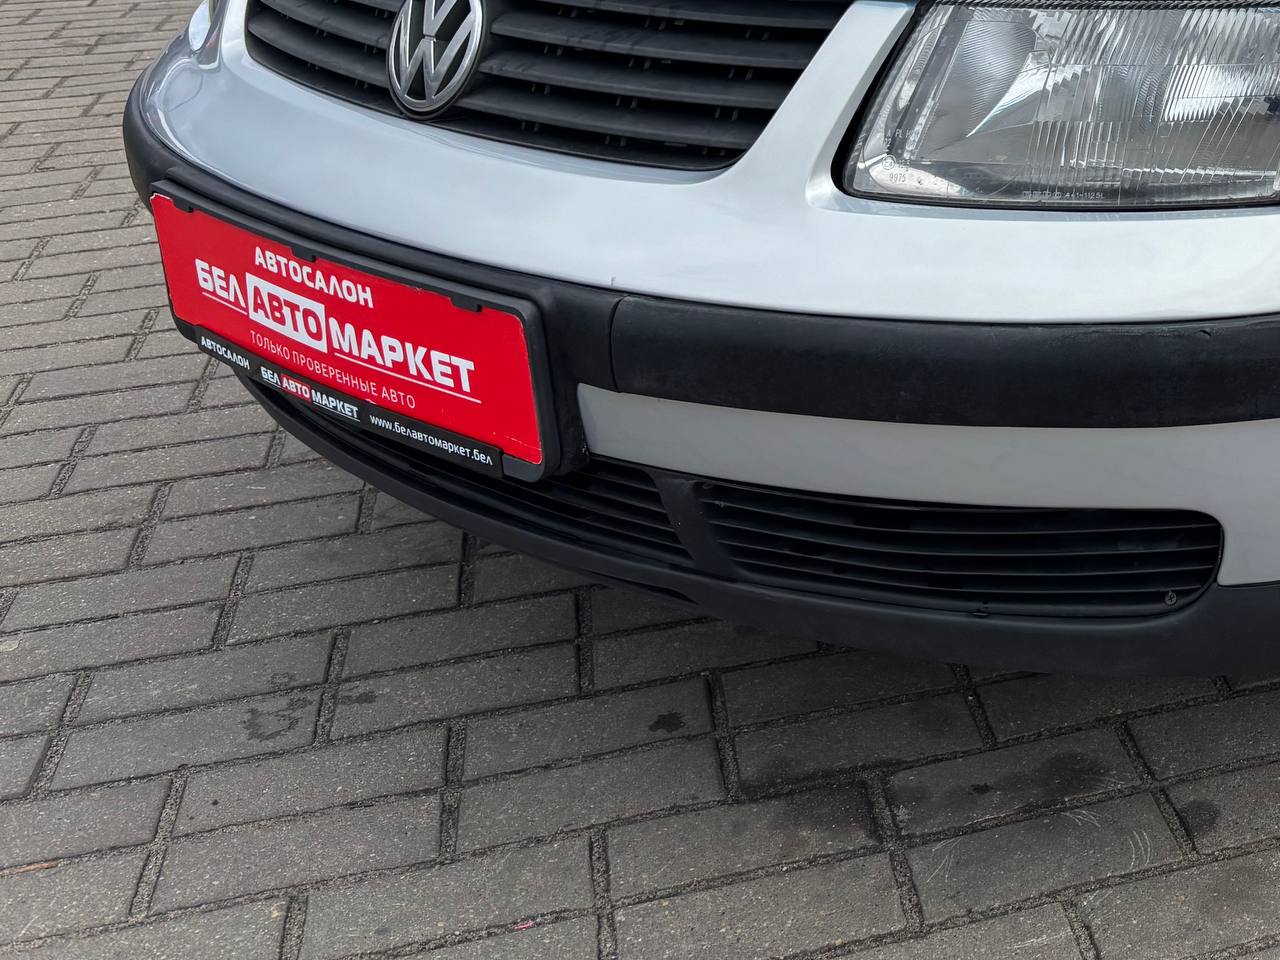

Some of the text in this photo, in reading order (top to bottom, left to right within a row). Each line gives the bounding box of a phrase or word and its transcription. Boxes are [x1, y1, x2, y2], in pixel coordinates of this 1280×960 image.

[255, 246, 374, 309] АВТОСАЛОН
[201, 336, 250, 370] АВТОСАЛОН
[370, 414, 494, 466] www.белавтомаркет.бел
[250, 330, 417, 409] ТОЛЬКО ПРОВЕРЕННЫЕ АВТО
